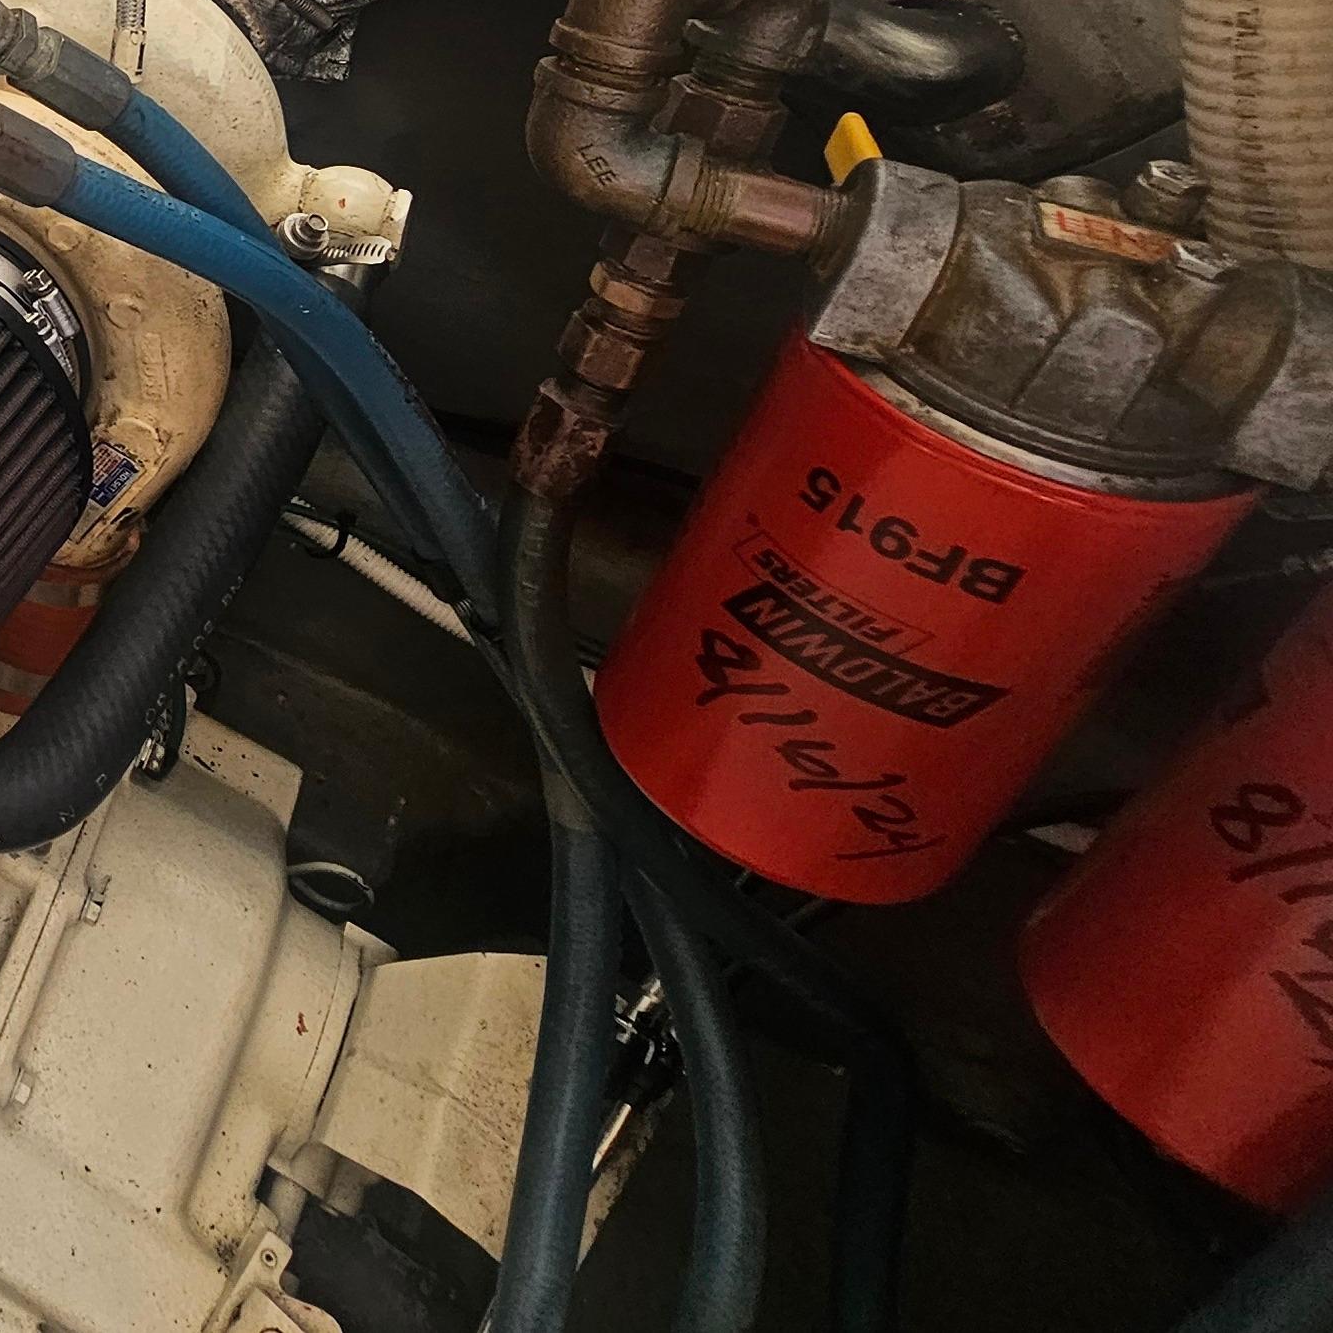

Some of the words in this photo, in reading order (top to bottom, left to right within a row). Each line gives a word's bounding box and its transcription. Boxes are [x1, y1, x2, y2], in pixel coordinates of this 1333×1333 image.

[577, 142, 617, 187] LEE
[799, 467, 1028, 605] BF915
[753, 546, 902, 644] FILTERS
[741, 595, 980, 719] BALDWIN
